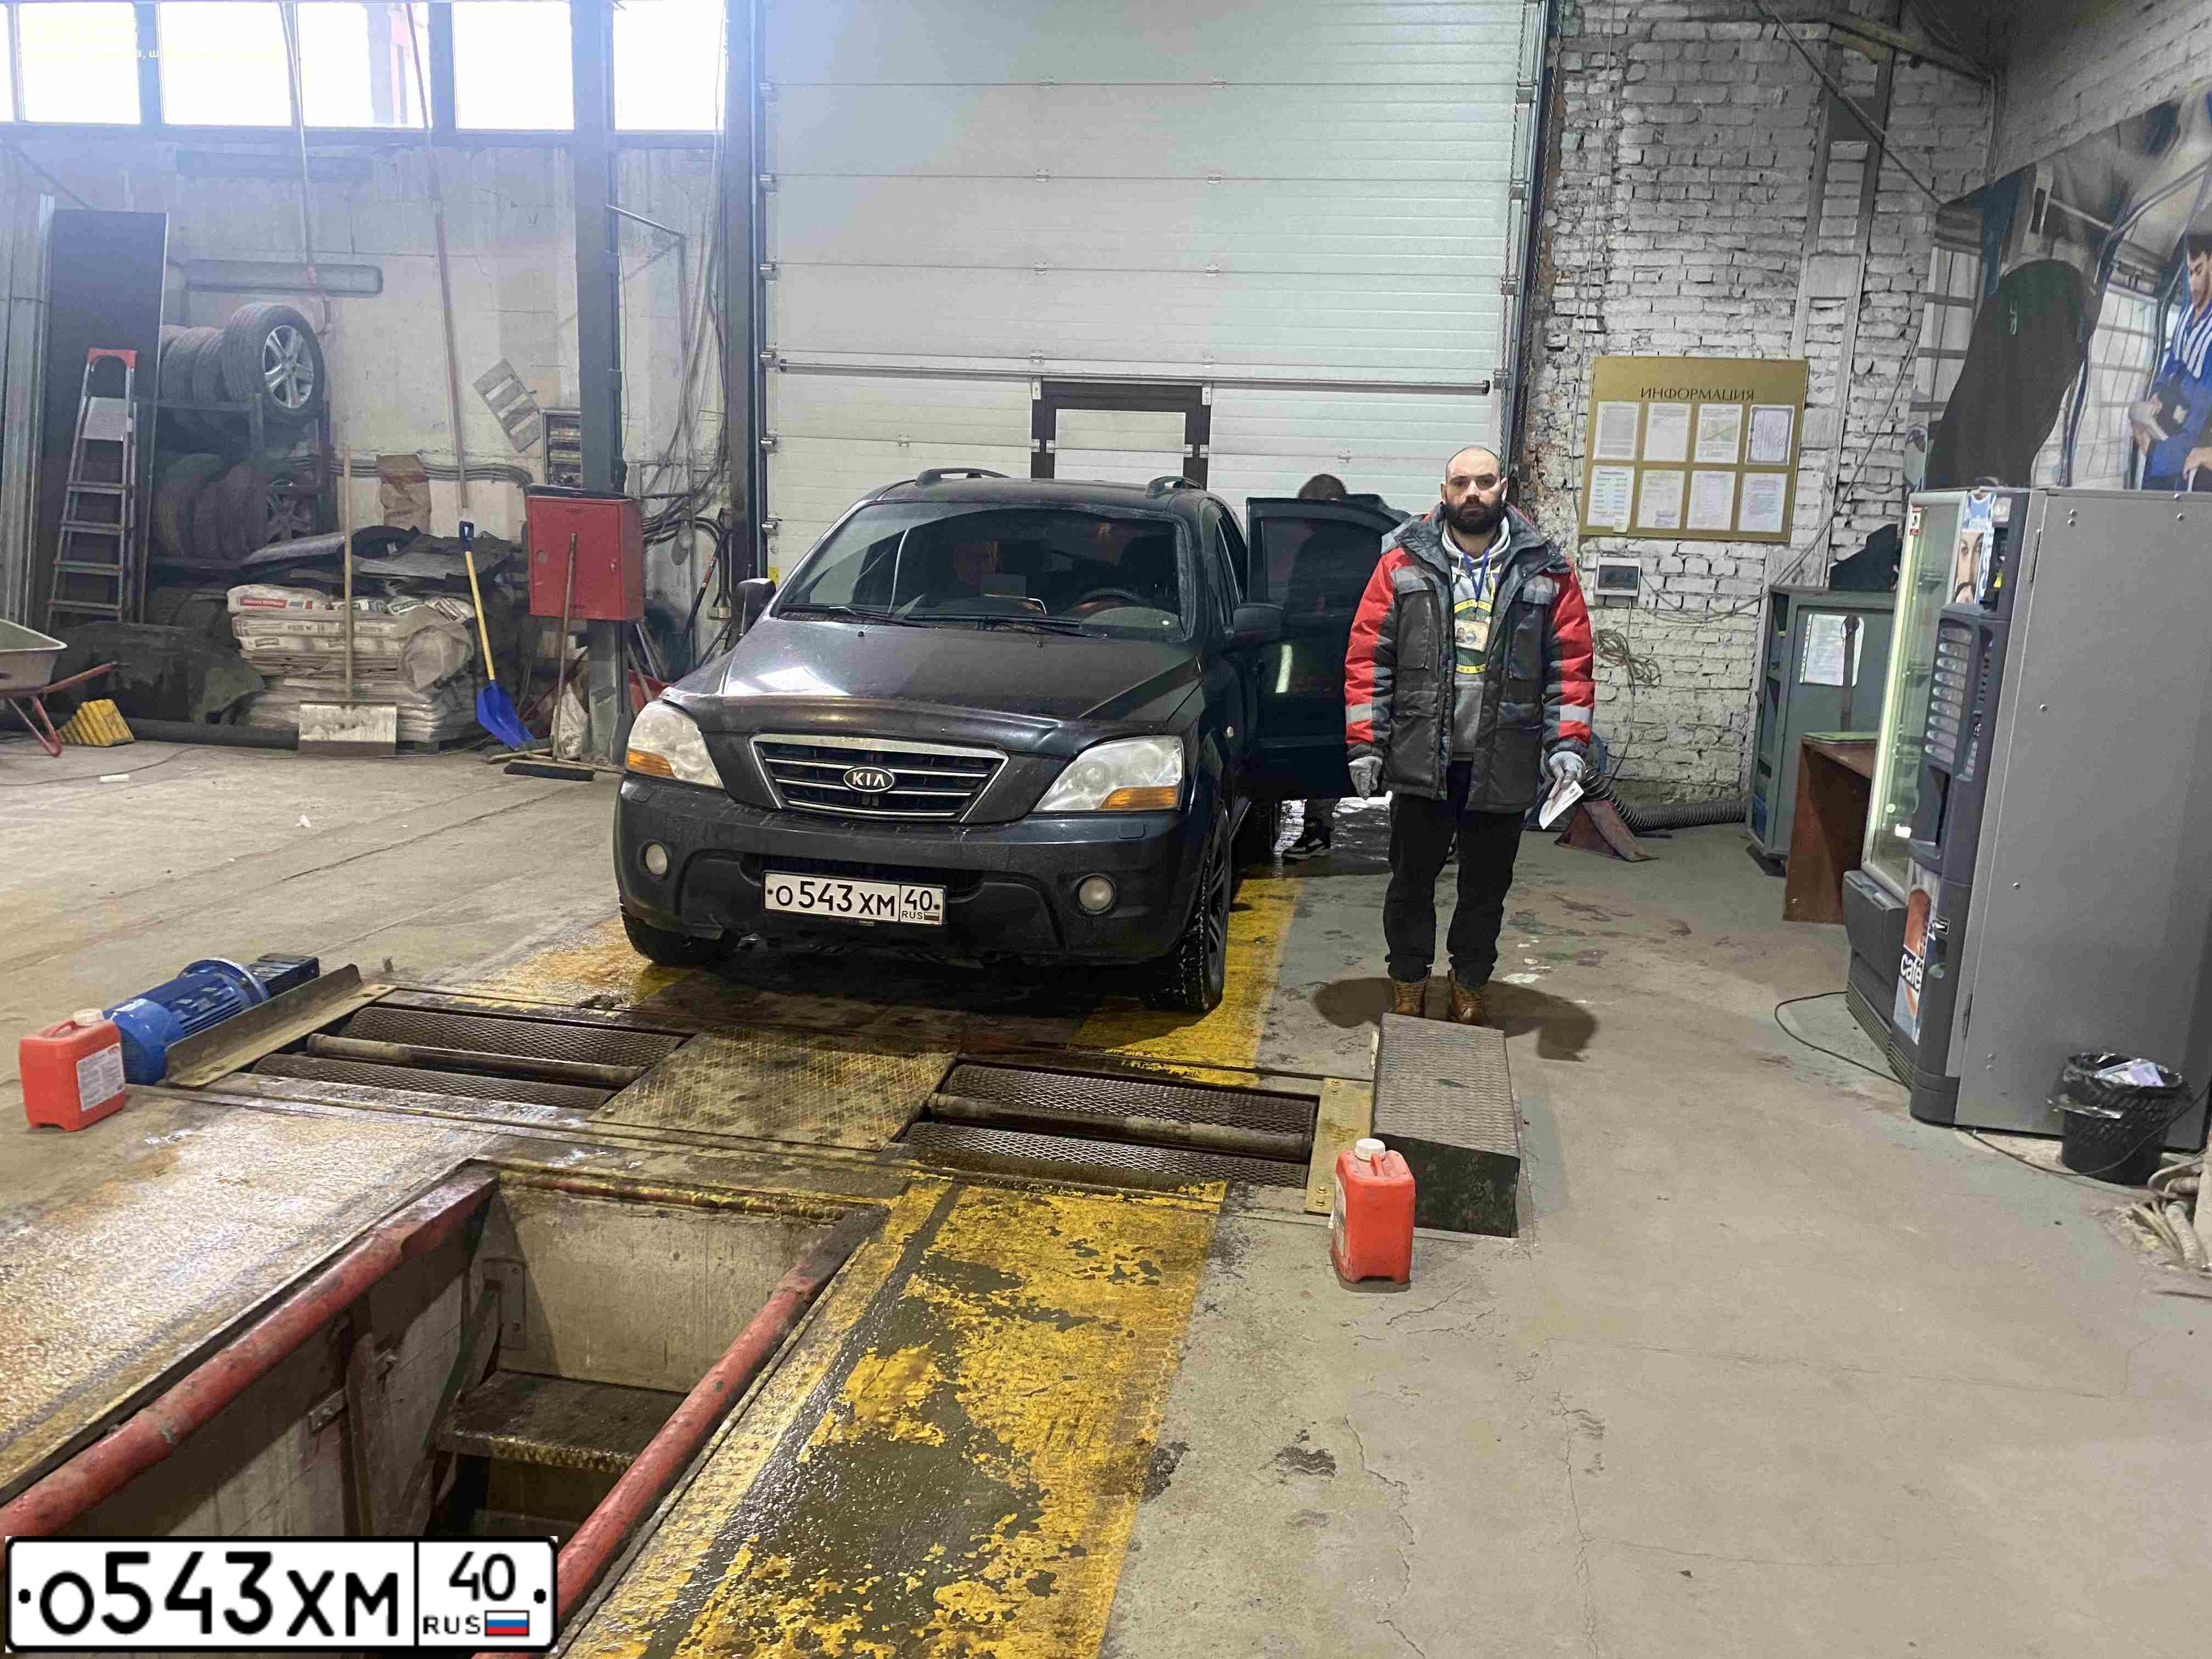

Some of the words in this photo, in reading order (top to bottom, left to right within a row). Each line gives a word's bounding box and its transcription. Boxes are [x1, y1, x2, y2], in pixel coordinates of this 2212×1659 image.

[1640, 386, 1756, 402] ИНФОРМАЦИЯ
[852, 772, 885, 787] KIA
[904, 889, 933, 911] 40
[901, 911, 923, 919] RUS
